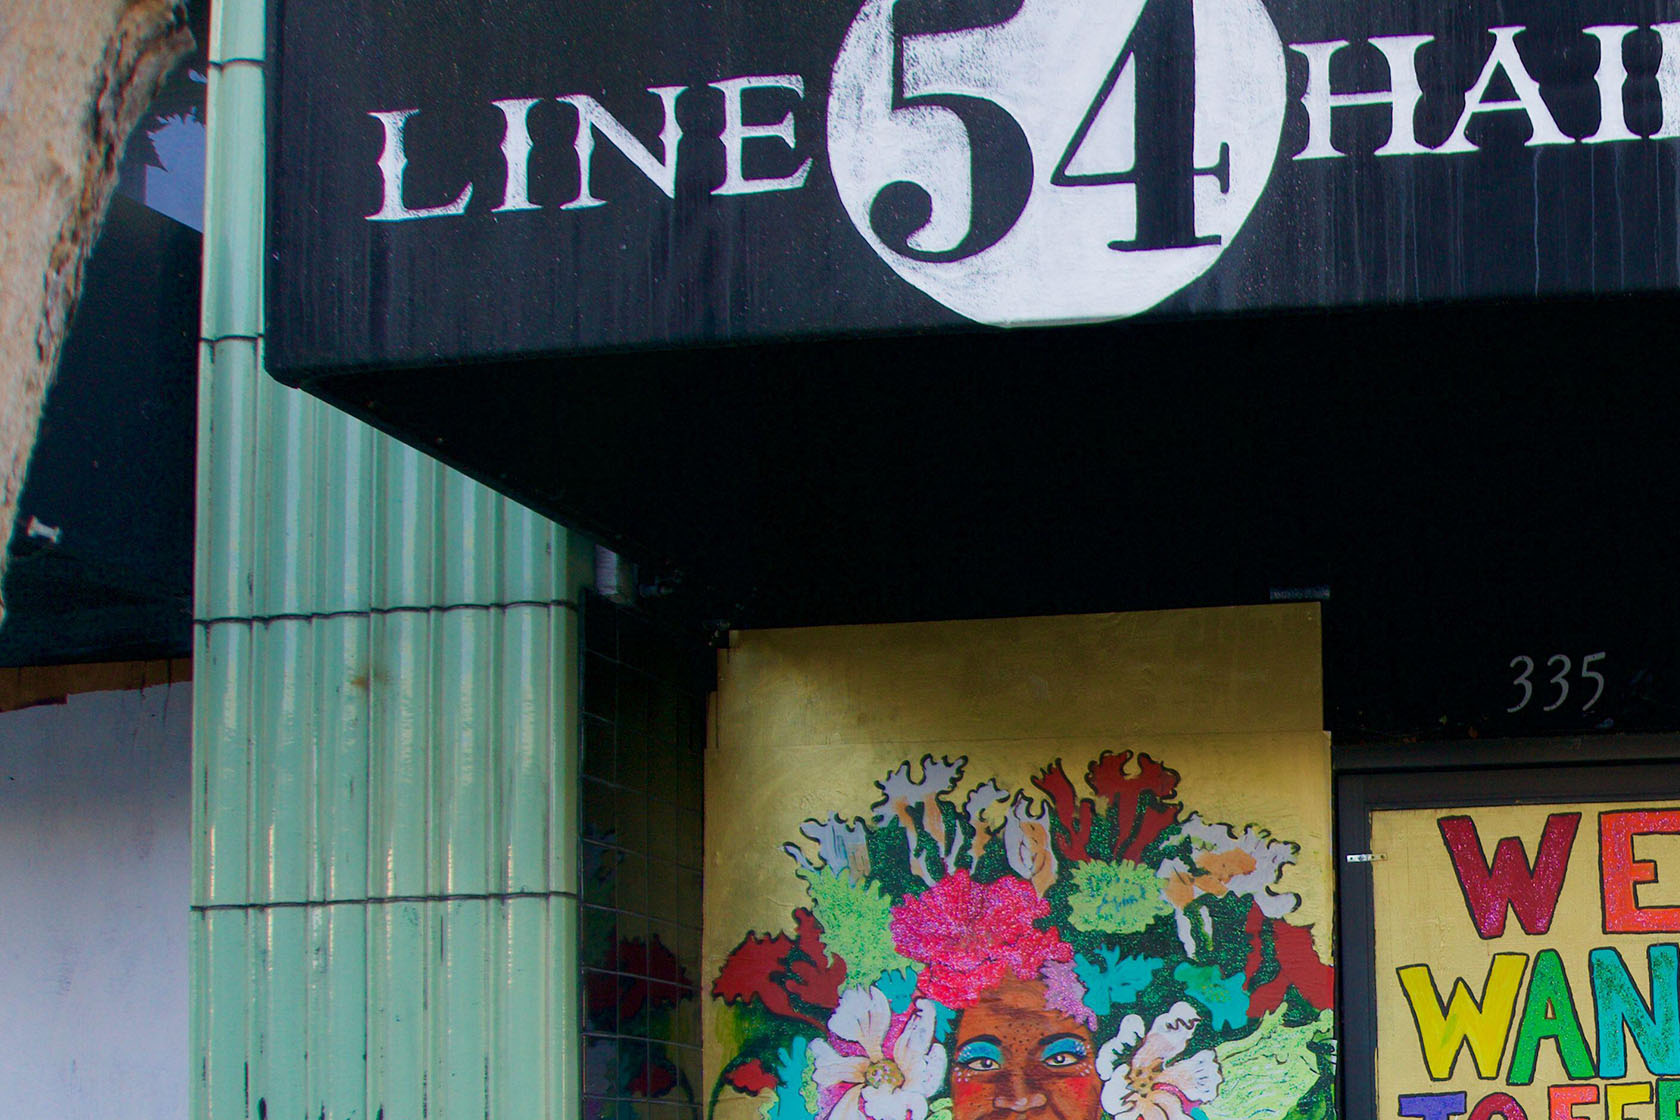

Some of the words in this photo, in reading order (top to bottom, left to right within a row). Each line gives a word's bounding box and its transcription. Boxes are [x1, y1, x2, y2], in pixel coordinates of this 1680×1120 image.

[367, 74, 813, 222] LINE
[867, 0, 1231, 263] 54
[1507, 652, 1606, 713] 335
